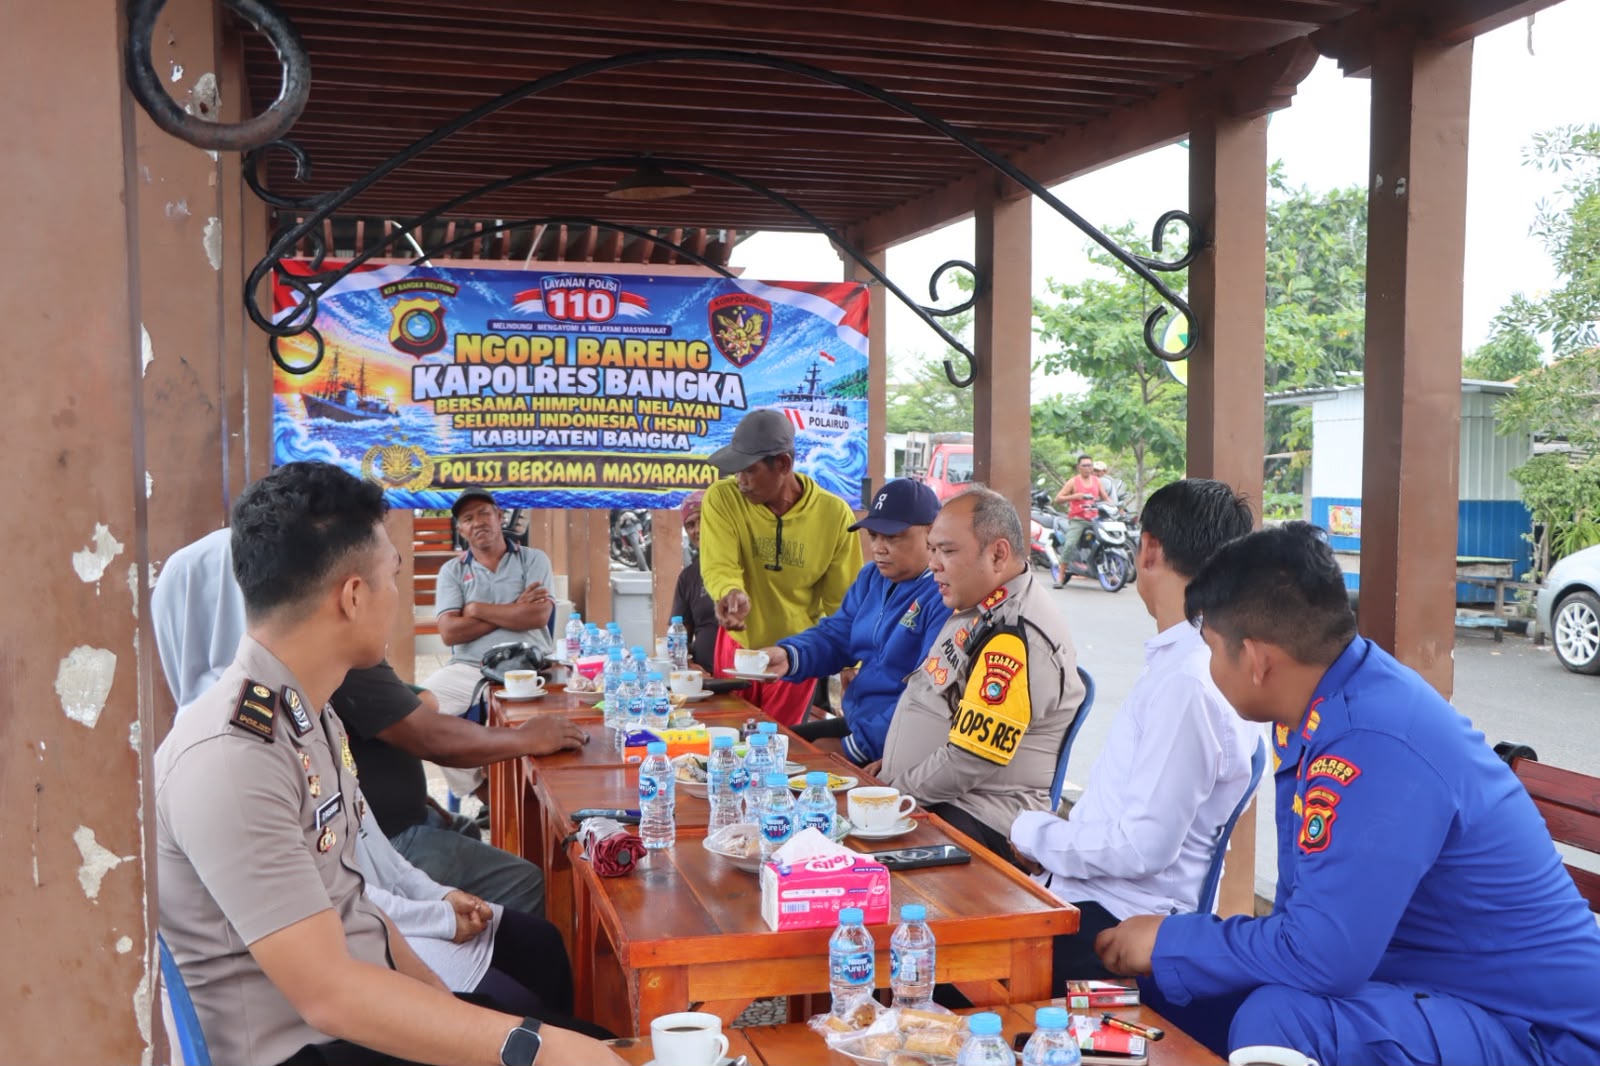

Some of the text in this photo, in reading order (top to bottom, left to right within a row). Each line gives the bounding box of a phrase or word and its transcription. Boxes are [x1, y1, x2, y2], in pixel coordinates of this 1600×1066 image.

[544, 278, 618, 292] LAYANAN POLISI
[550, 291, 611, 319] 110
[492, 322, 533, 331] MELINDUNGI
[537, 323, 579, 332] MENGAYOMI
[622, 326, 667, 334] MASYARAKAT
[456, 334, 709, 370] NGOPI BARENG
[414, 365, 746, 408] KAPOLRES BANGKA
[436, 397, 720, 419] BERSAMA HIMPUNAN NELAYAN
[453, 413, 536, 428] SELURUH
[540, 413, 639, 429] INDONESIA
[809, 416, 850, 430] POLAIRUD
[472, 430, 690, 450] KABUPATEN BANGKA
[439, 460, 503, 483] POLISI
[507, 460, 597, 483] BERSAMA
[942, 638, 960, 671] POLRI
[959, 709, 994, 744] OPS
[990, 722, 1022, 754] RES
[762, 823, 791, 833] Pure Life
[817, 821, 830, 832] Life
[842, 964, 862, 973] Pure
